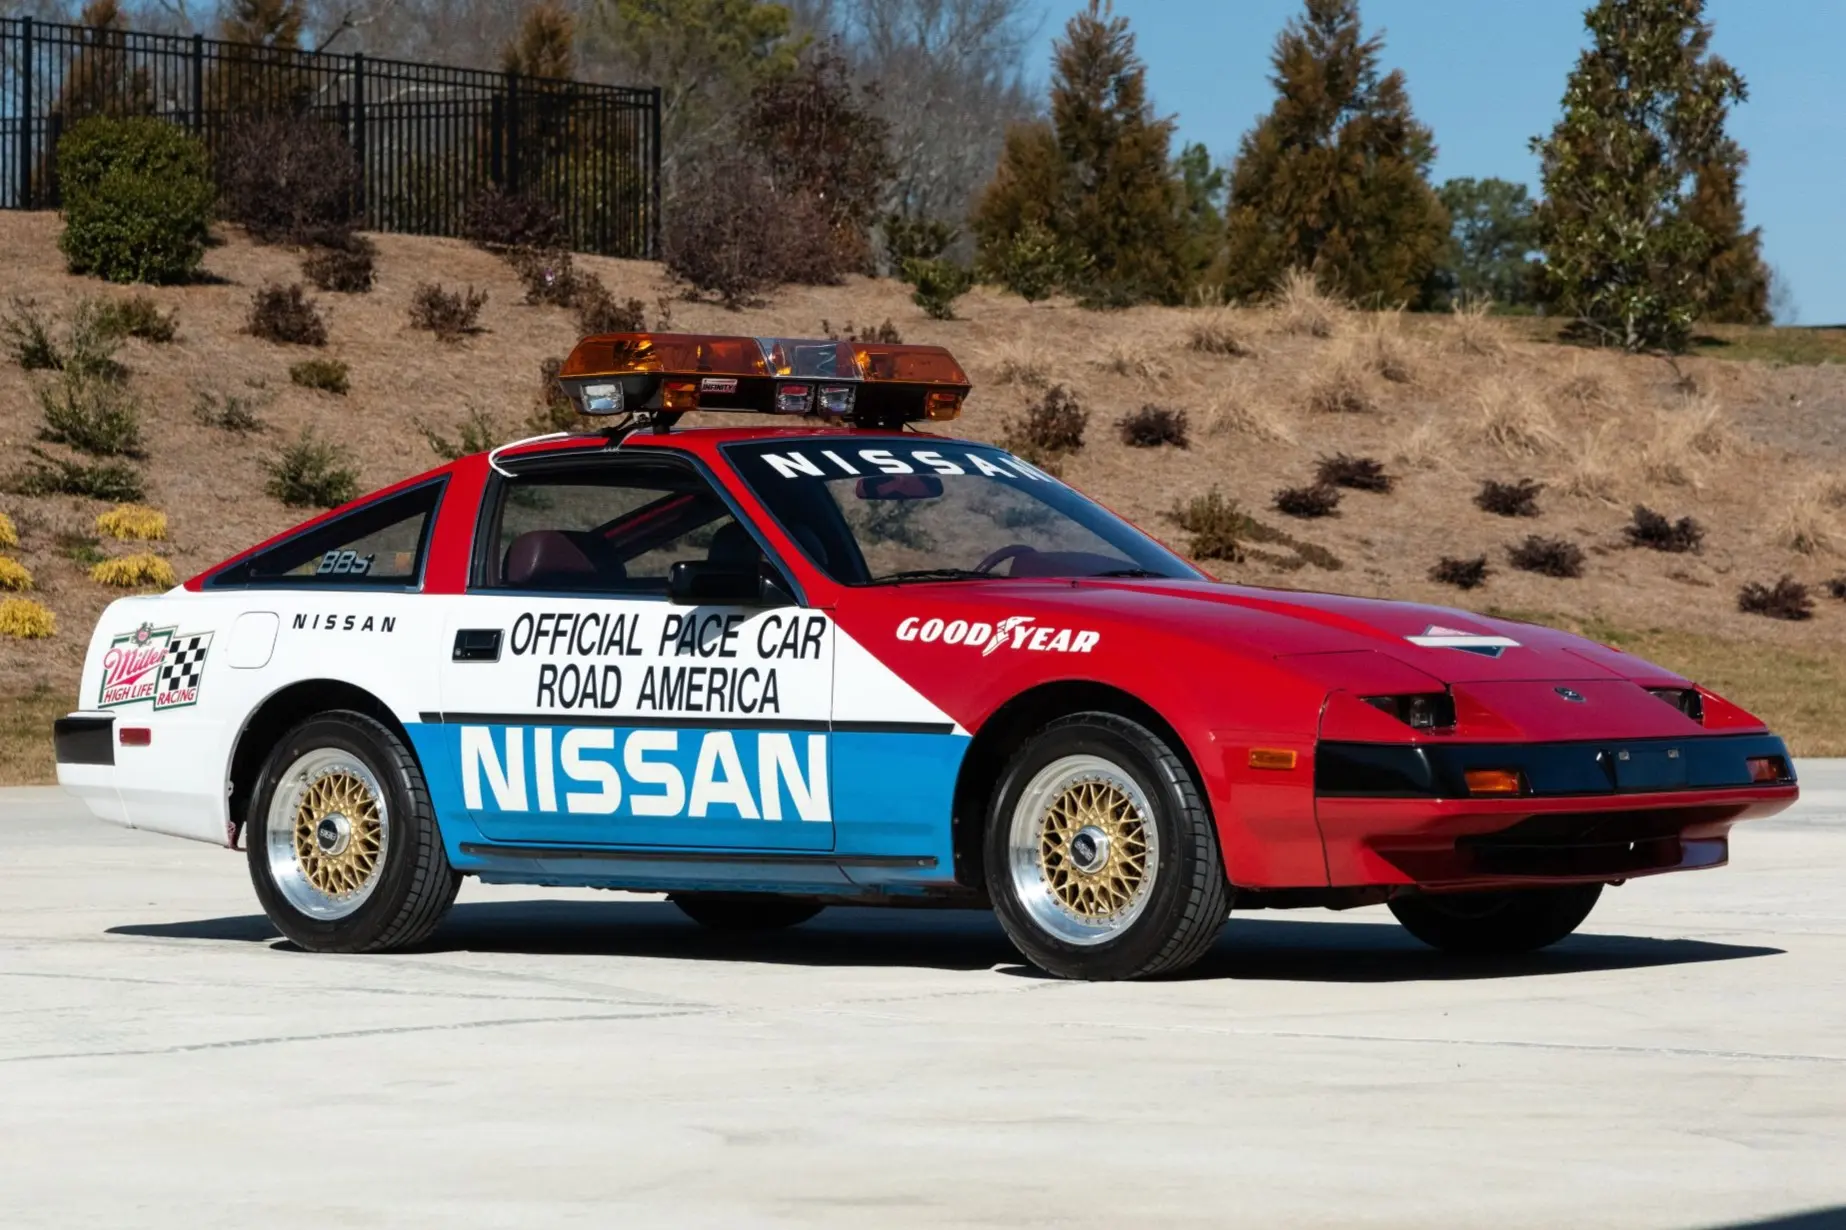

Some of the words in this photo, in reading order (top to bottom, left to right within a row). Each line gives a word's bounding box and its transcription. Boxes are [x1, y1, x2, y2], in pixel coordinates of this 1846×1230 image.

[760, 449, 1051, 482] NISSAN
[292, 613, 396, 632] NISSAN
[510, 612, 643, 656] OFFICIAL
[658, 613, 742, 658] PACE
[757, 615, 826, 659] CAR
[103, 648, 169, 686] Miller
[104, 687, 131, 703] HIGH
[131, 683, 154, 699] LIFE
[157, 688, 196, 706] RACING
[536, 664, 622, 709] ROAD
[637, 665, 780, 713] AMERICA
[460, 725, 832, 822] NISSAN
